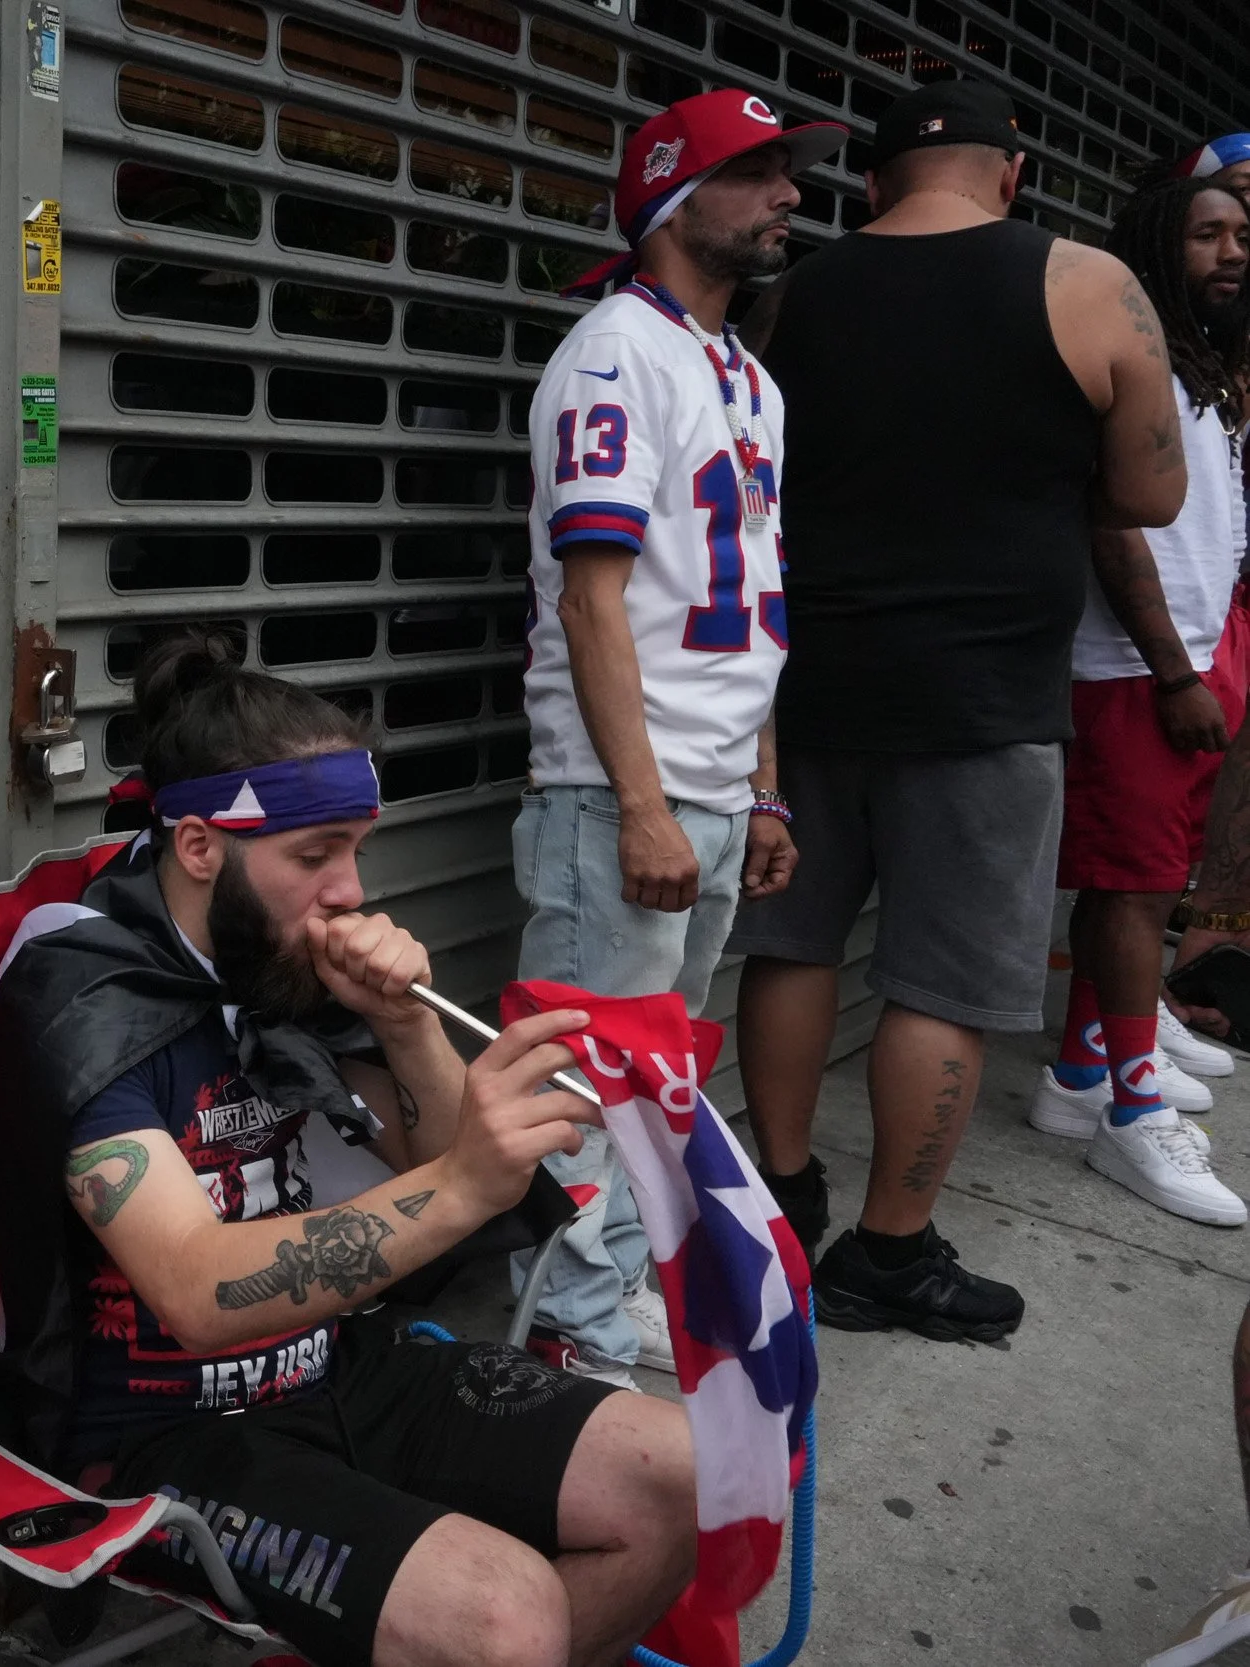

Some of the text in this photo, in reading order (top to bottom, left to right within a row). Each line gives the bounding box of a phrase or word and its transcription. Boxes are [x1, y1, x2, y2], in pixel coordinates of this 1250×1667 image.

[742, 95, 778, 126] C
[24, 225, 58, 234] ROLLING GATES
[46, 267, 59, 275] 24/7
[22, 388, 56, 396] ROLLING GATES
[555, 403, 628, 485] 13
[195, 1328, 329, 1409] JEY USO
